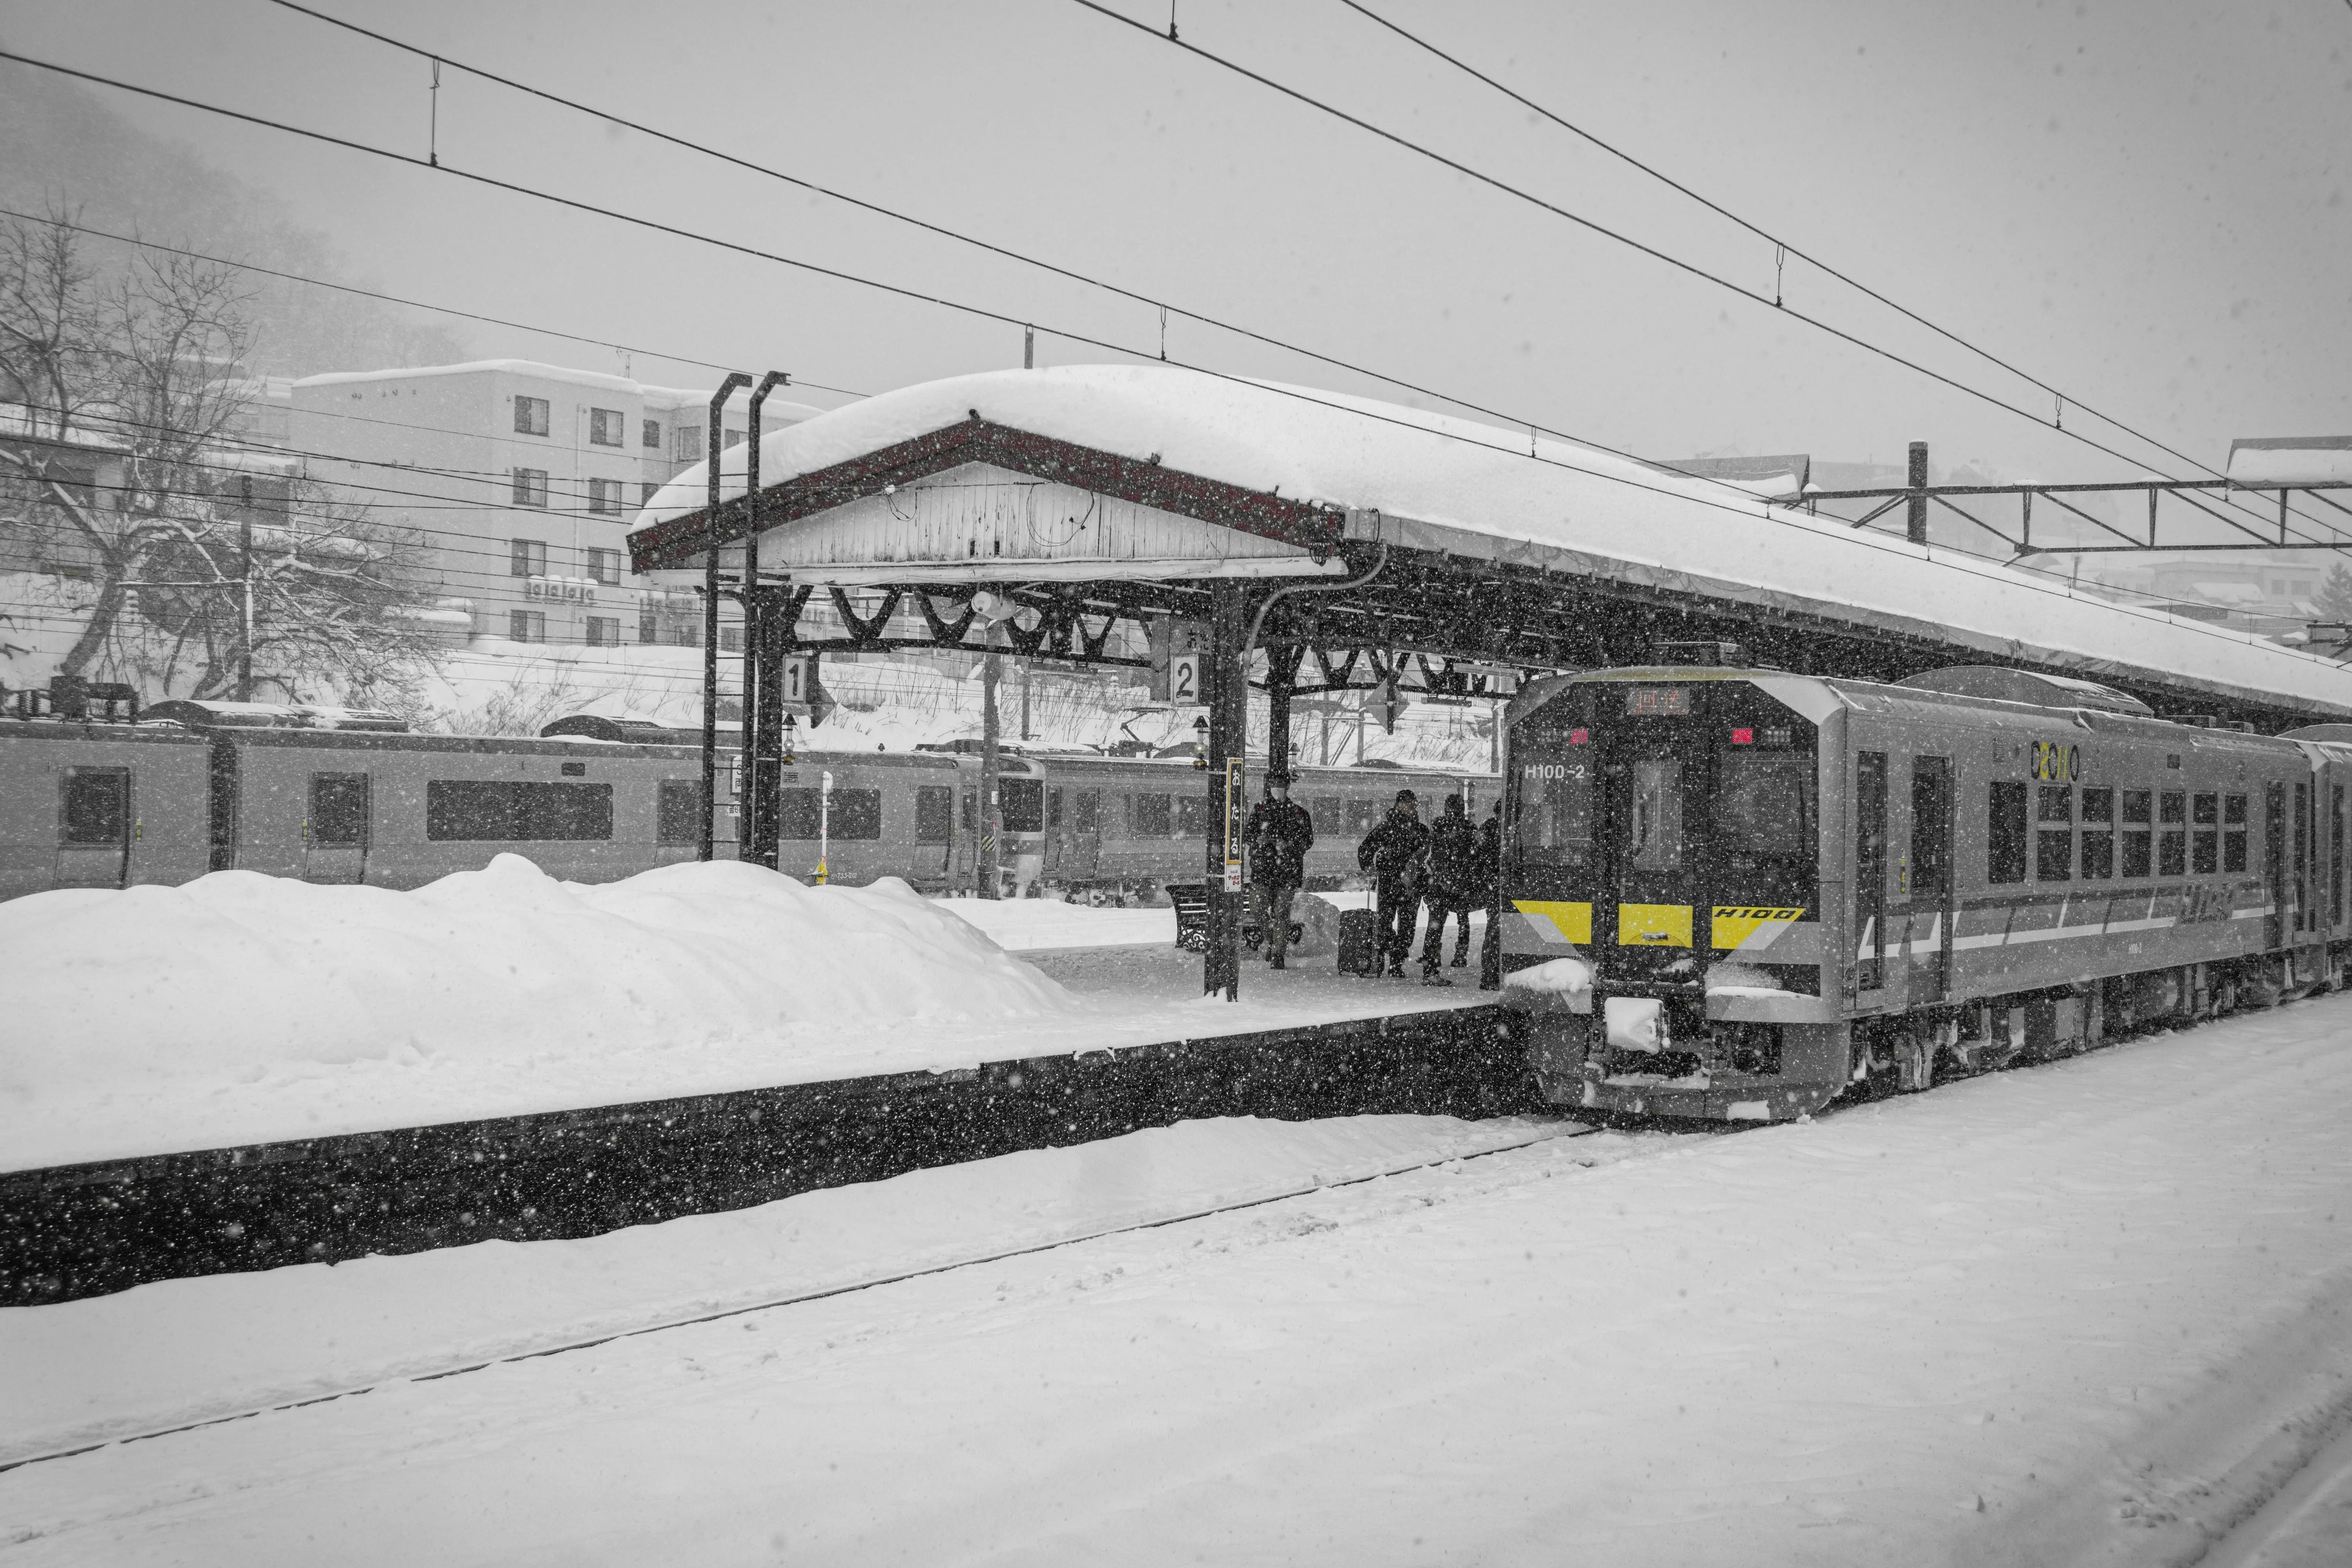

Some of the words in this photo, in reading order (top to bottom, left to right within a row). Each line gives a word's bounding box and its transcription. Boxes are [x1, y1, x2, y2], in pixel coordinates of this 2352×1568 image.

[788, 663, 799, 696] 1
[1176, 663, 1194, 698] 2
[1639, 689, 1683, 709] 回送
[1525, 765, 1584, 779] H100-2
[1231, 769, 1241, 854] おたる
[1714, 908, 1796, 919] H100
[2129, 943, 2142, 954] H100-2
